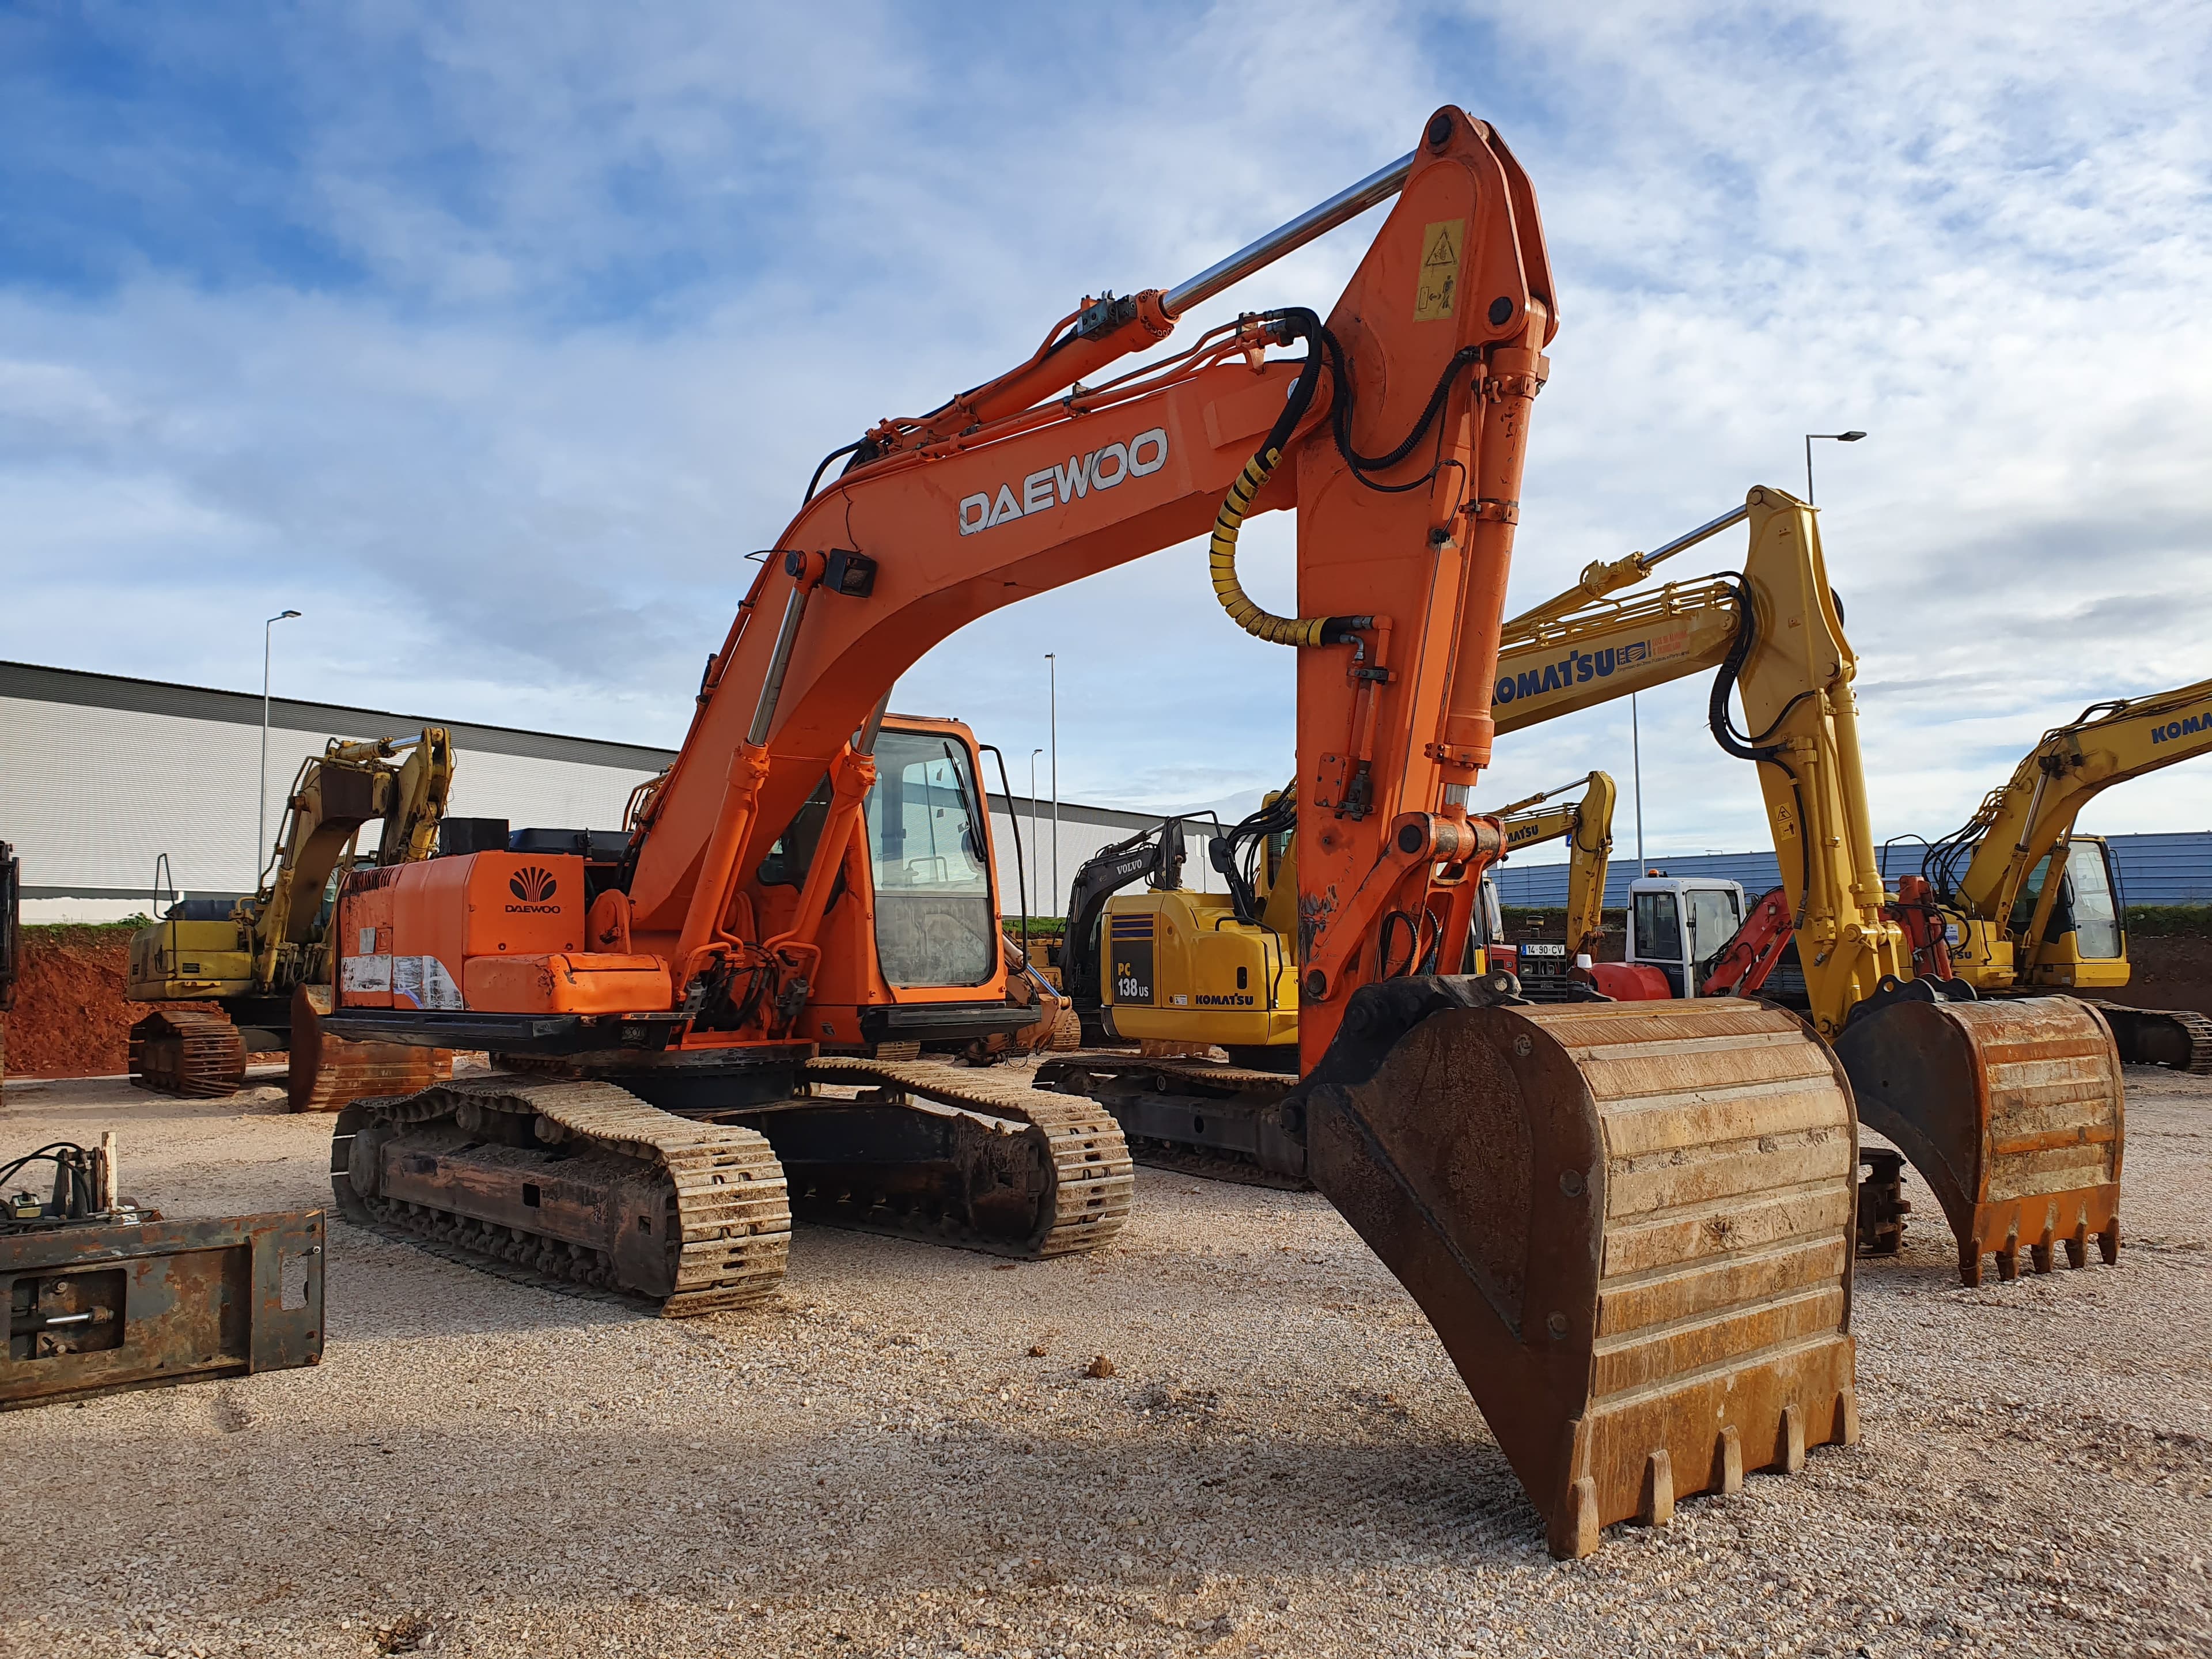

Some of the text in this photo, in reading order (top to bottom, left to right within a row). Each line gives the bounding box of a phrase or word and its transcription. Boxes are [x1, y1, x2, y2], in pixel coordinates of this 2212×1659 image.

[959, 427, 1168, 536] DAEWOO
[2151, 712, 2212, 744] KOMA
[1507, 824, 1539, 843] MATSU
[1116, 859, 1142, 875] VOLVO
[505, 905, 561, 914] DAEWOO
[1118, 963, 1131, 976] PC
[1195, 993, 1253, 1005] KOMATSU
